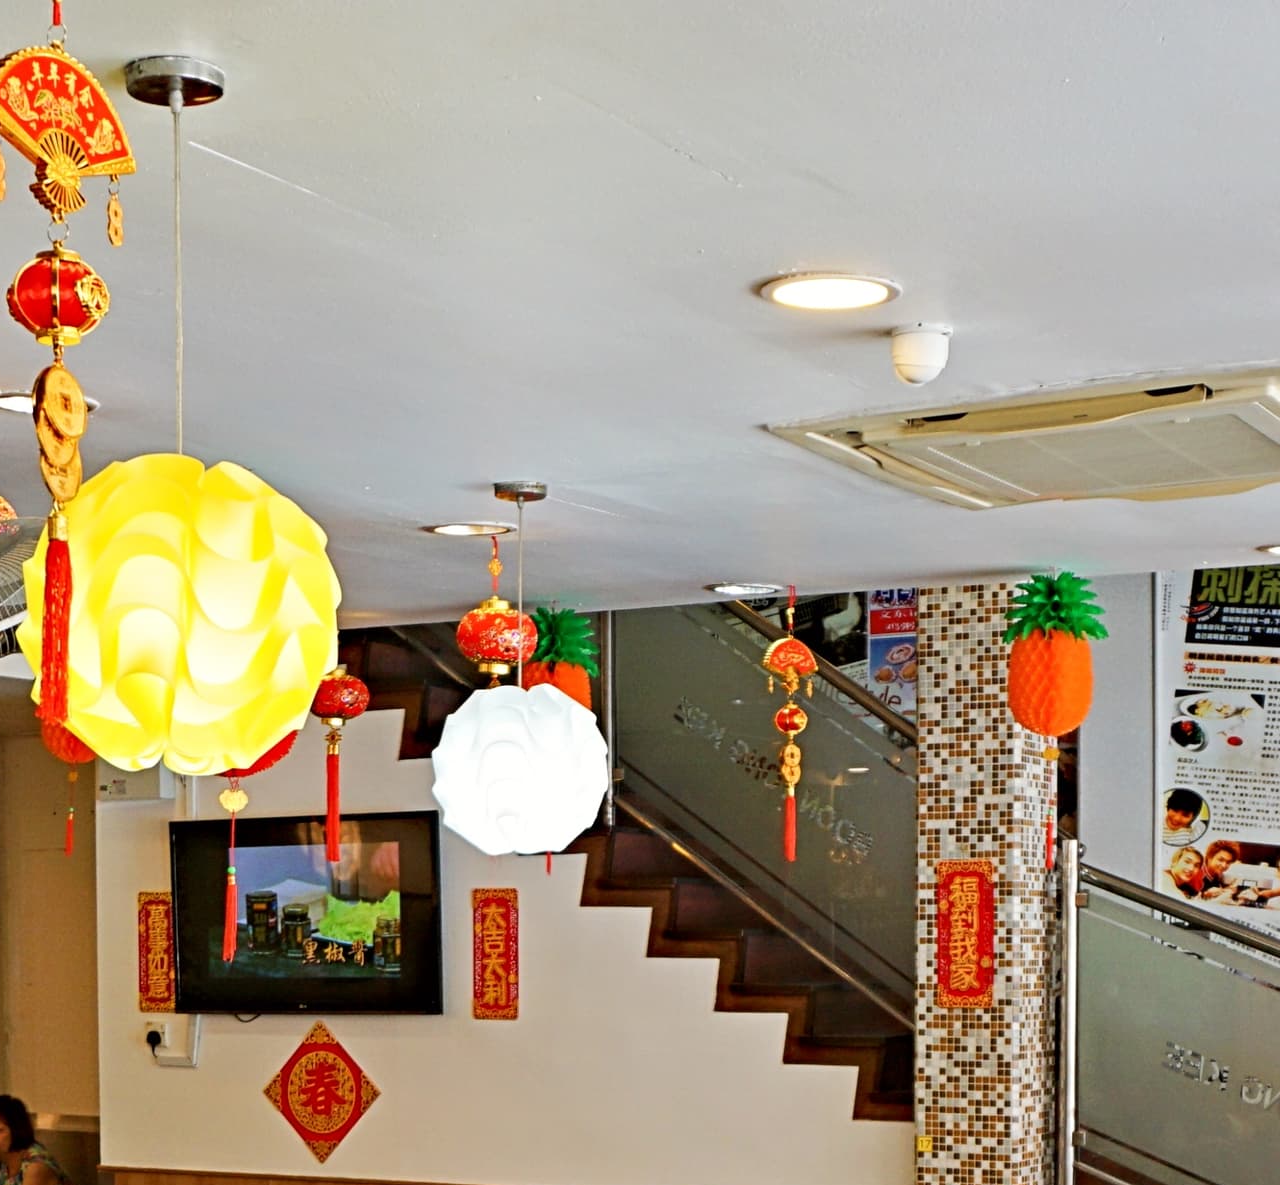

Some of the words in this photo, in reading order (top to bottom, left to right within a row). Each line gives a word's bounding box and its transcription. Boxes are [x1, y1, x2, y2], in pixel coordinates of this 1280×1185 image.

[482, 903, 508, 1007] 大吉大利
[299, 1061, 347, 1117] 春
[919, 1138, 932, 1149] 17
